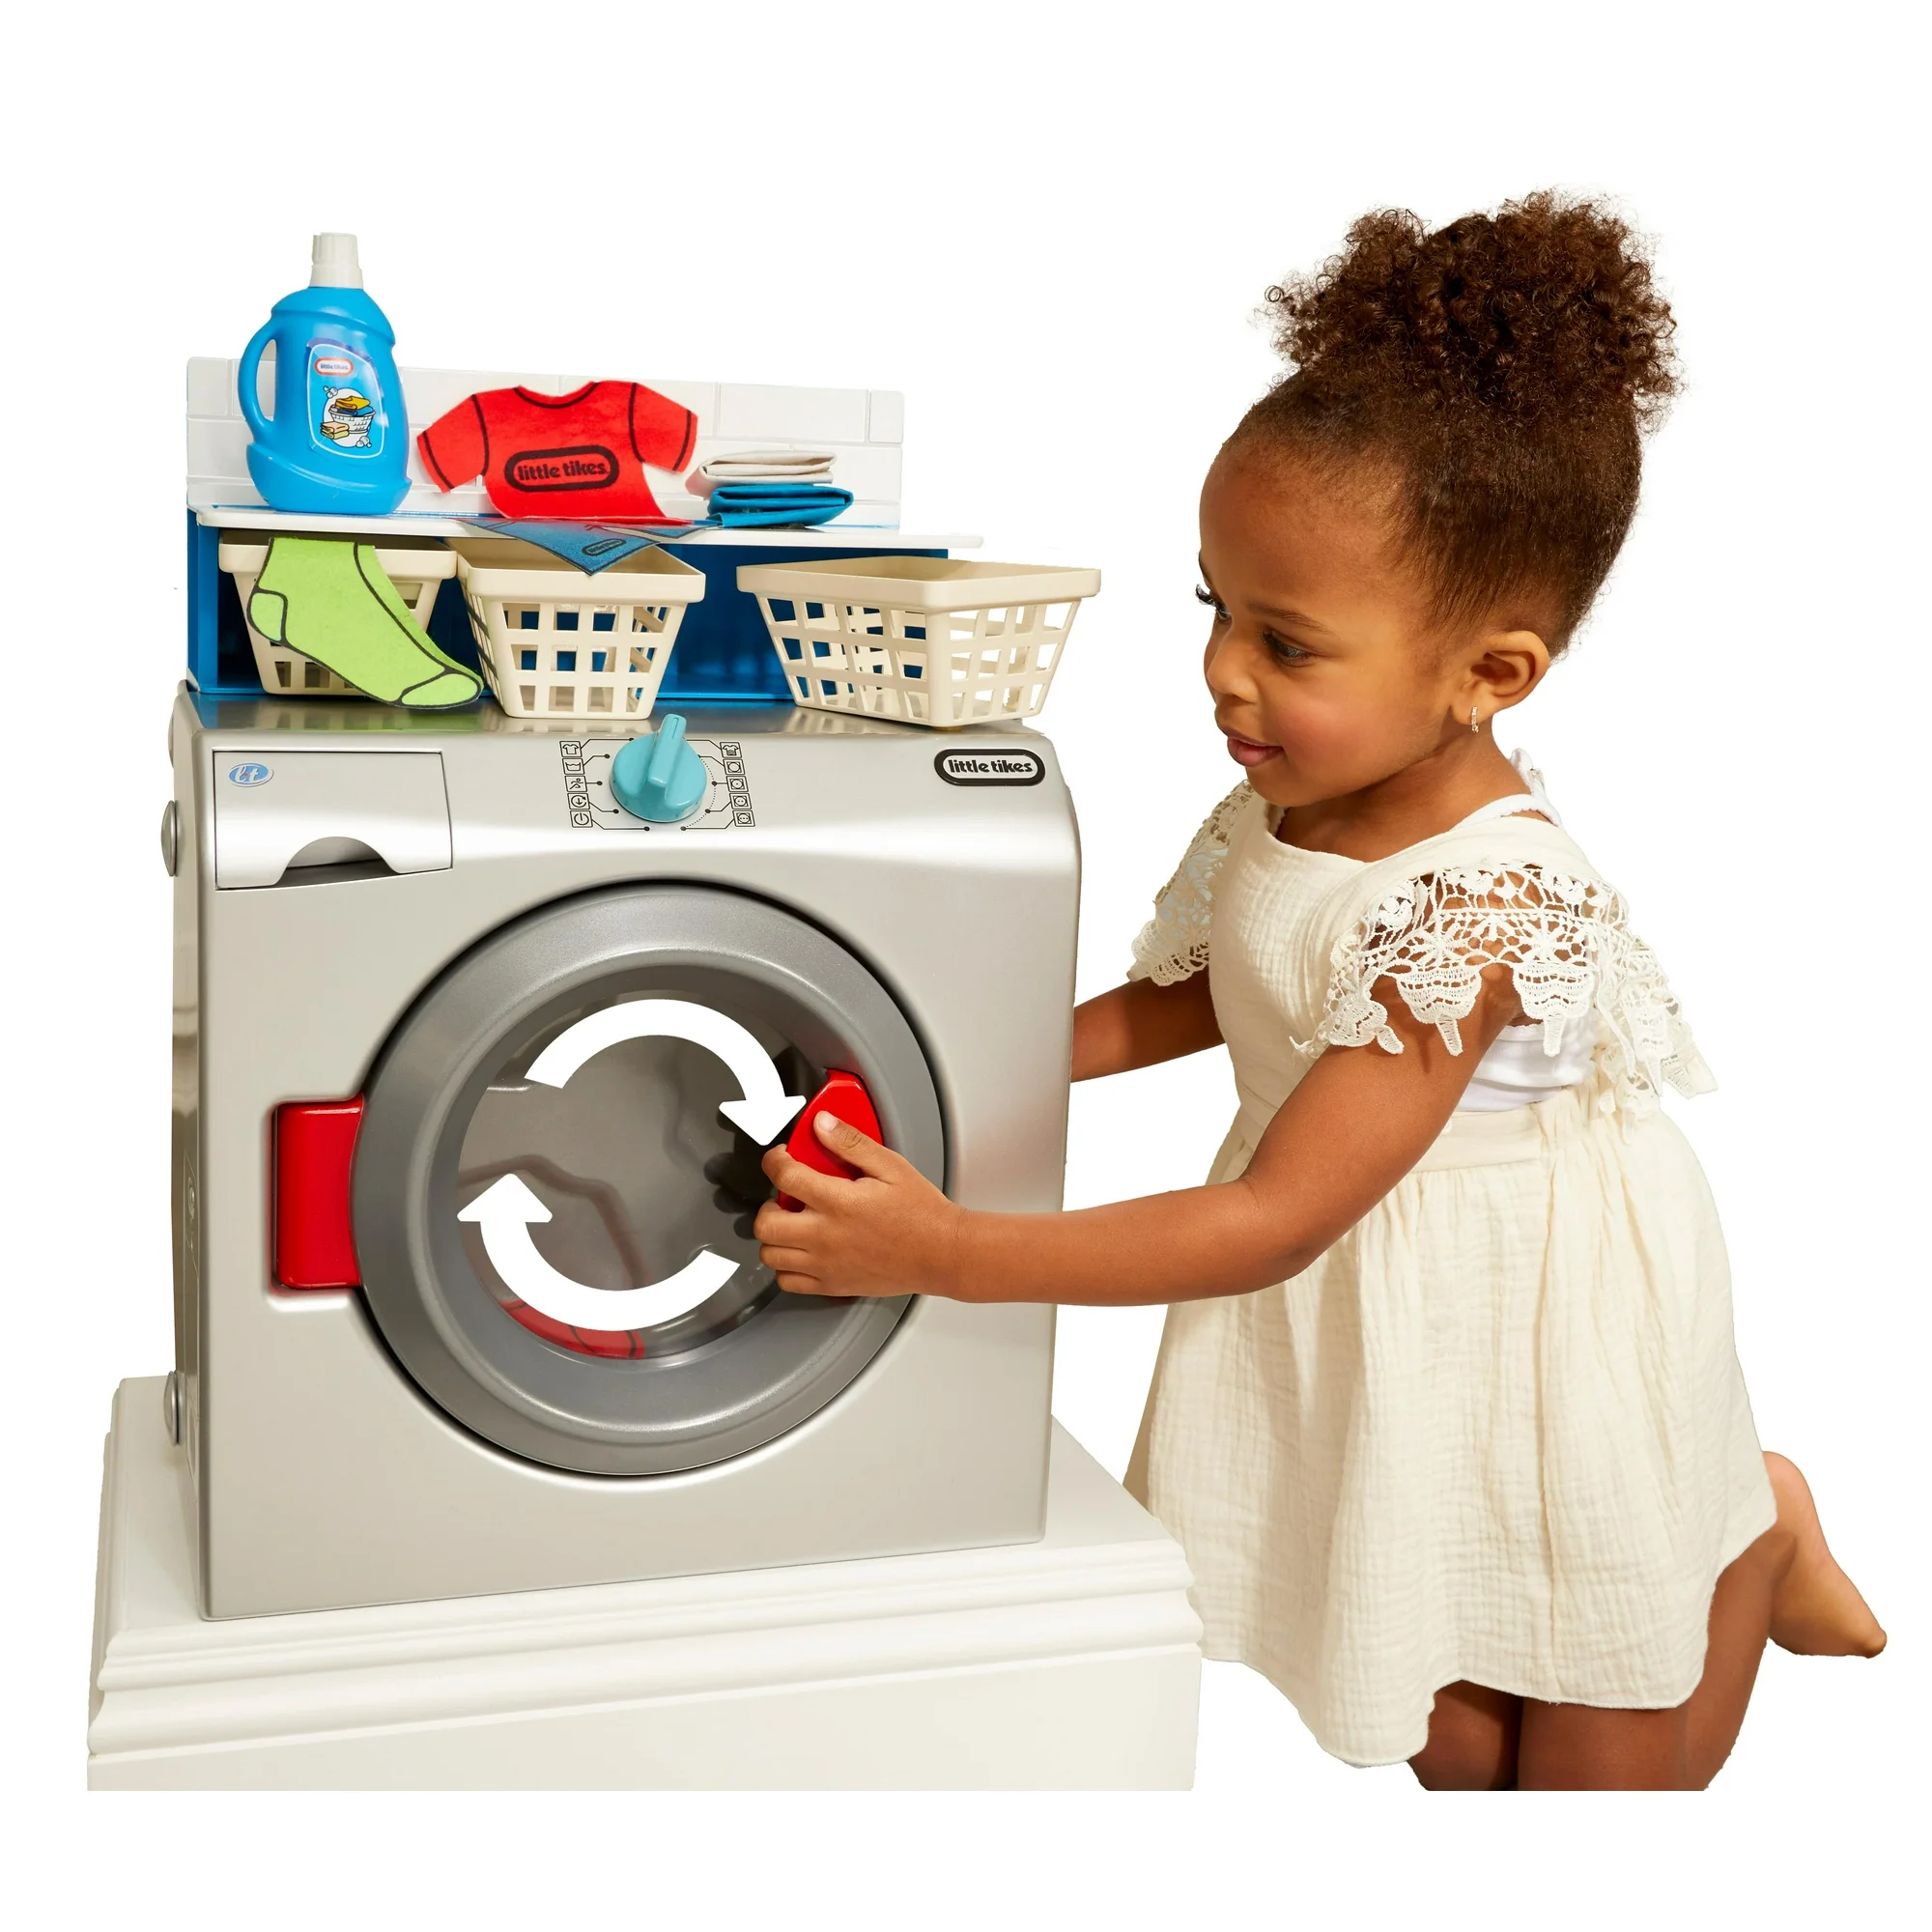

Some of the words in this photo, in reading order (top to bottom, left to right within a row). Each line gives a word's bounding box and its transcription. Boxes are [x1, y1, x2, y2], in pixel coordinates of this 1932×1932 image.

[518, 464, 560, 480] little
[562, 460, 608, 476] tikes
[948, 759, 989, 773] little
[990, 759, 1033, 773] tikes
